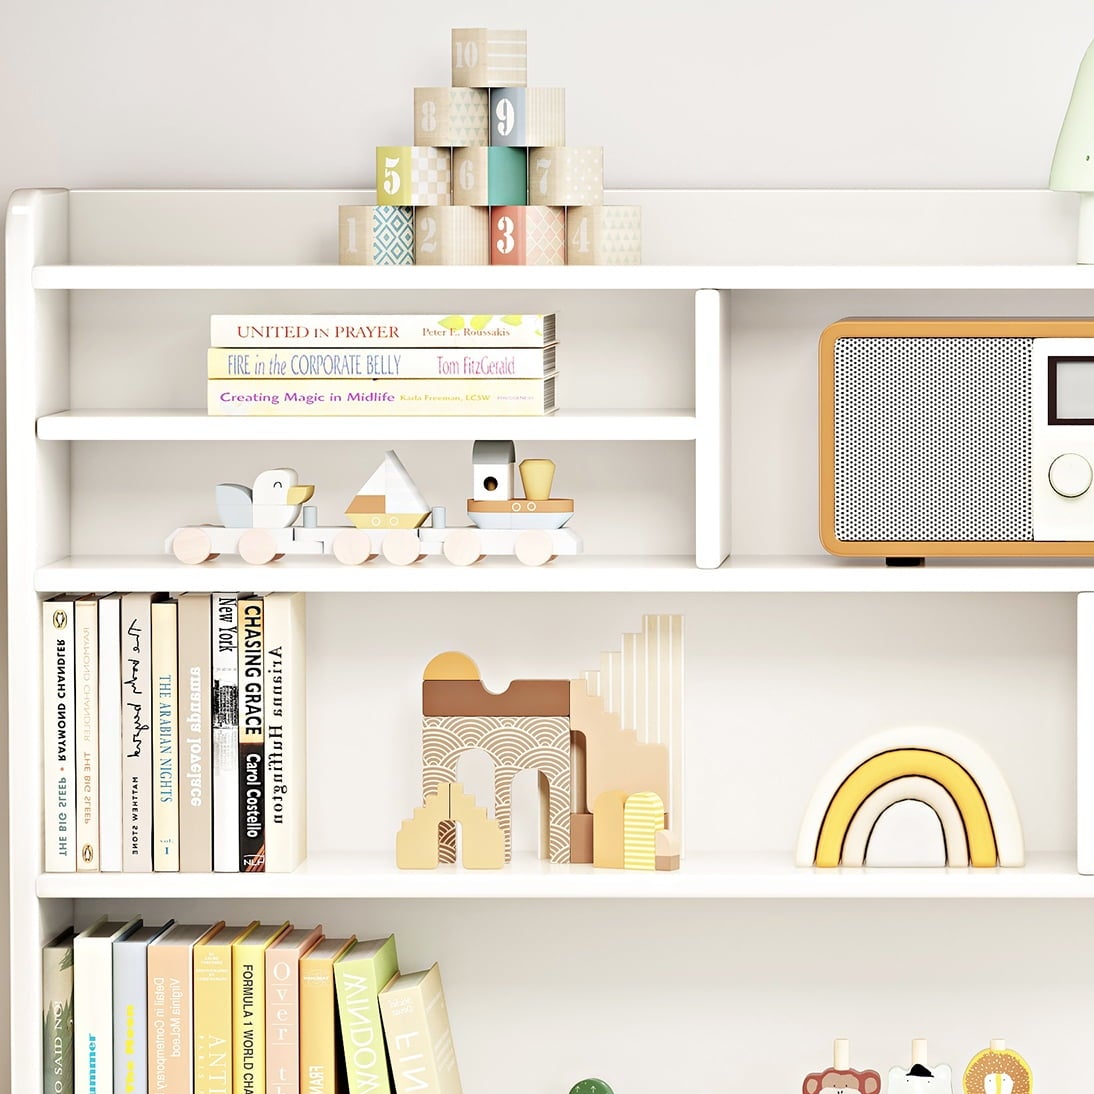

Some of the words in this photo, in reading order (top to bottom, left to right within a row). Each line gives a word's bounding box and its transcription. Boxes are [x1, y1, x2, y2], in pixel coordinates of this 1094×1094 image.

[455, 41, 478, 68] 10
[422, 101, 436, 132] 8
[496, 98, 514, 136] 9
[383, 157, 401, 194] 5
[459, 160, 474, 190] 6
[536, 160, 551, 194] 7
[345, 218, 358, 252] 1
[421, 218, 437, 252] 2
[497, 216, 514, 253] 3
[572, 218, 590, 252] 4
[237, 325, 309, 338] UNITED
[335, 325, 400, 338] PRAYER
[422, 328, 448, 336] Peter
[463, 327, 511, 337] Roussakis
[227, 355, 251, 375] FIRE
[254, 355, 265, 375] in
[268, 354, 287, 375] the
[290, 355, 362, 375] CORPORATE
[367, 355, 401, 375] BELLY
[437, 356, 460, 375] Tom
[463, 355, 516, 375] FitzGerald
[220, 392, 279, 404] Creating
[284, 392, 325, 404] Magic
[330, 392, 342, 402] in
[347, 392, 395, 402] Midlife
[218, 597, 237, 623] New
[218, 626, 237, 653] York
[244, 605, 261, 678] CHASING
[158, 674, 172, 698] THE
[244, 682, 261, 735] GRACE
[158, 701, 172, 755] ARABIAN
[158, 758, 172, 803] NIGHTS
[246, 754, 261, 785] Carol
[246, 789, 261, 837] Costello
[242, 964, 255, 1018] FORMULA
[272, 961, 293, 1043] Over
[242, 1029, 255, 1069] WORLD
